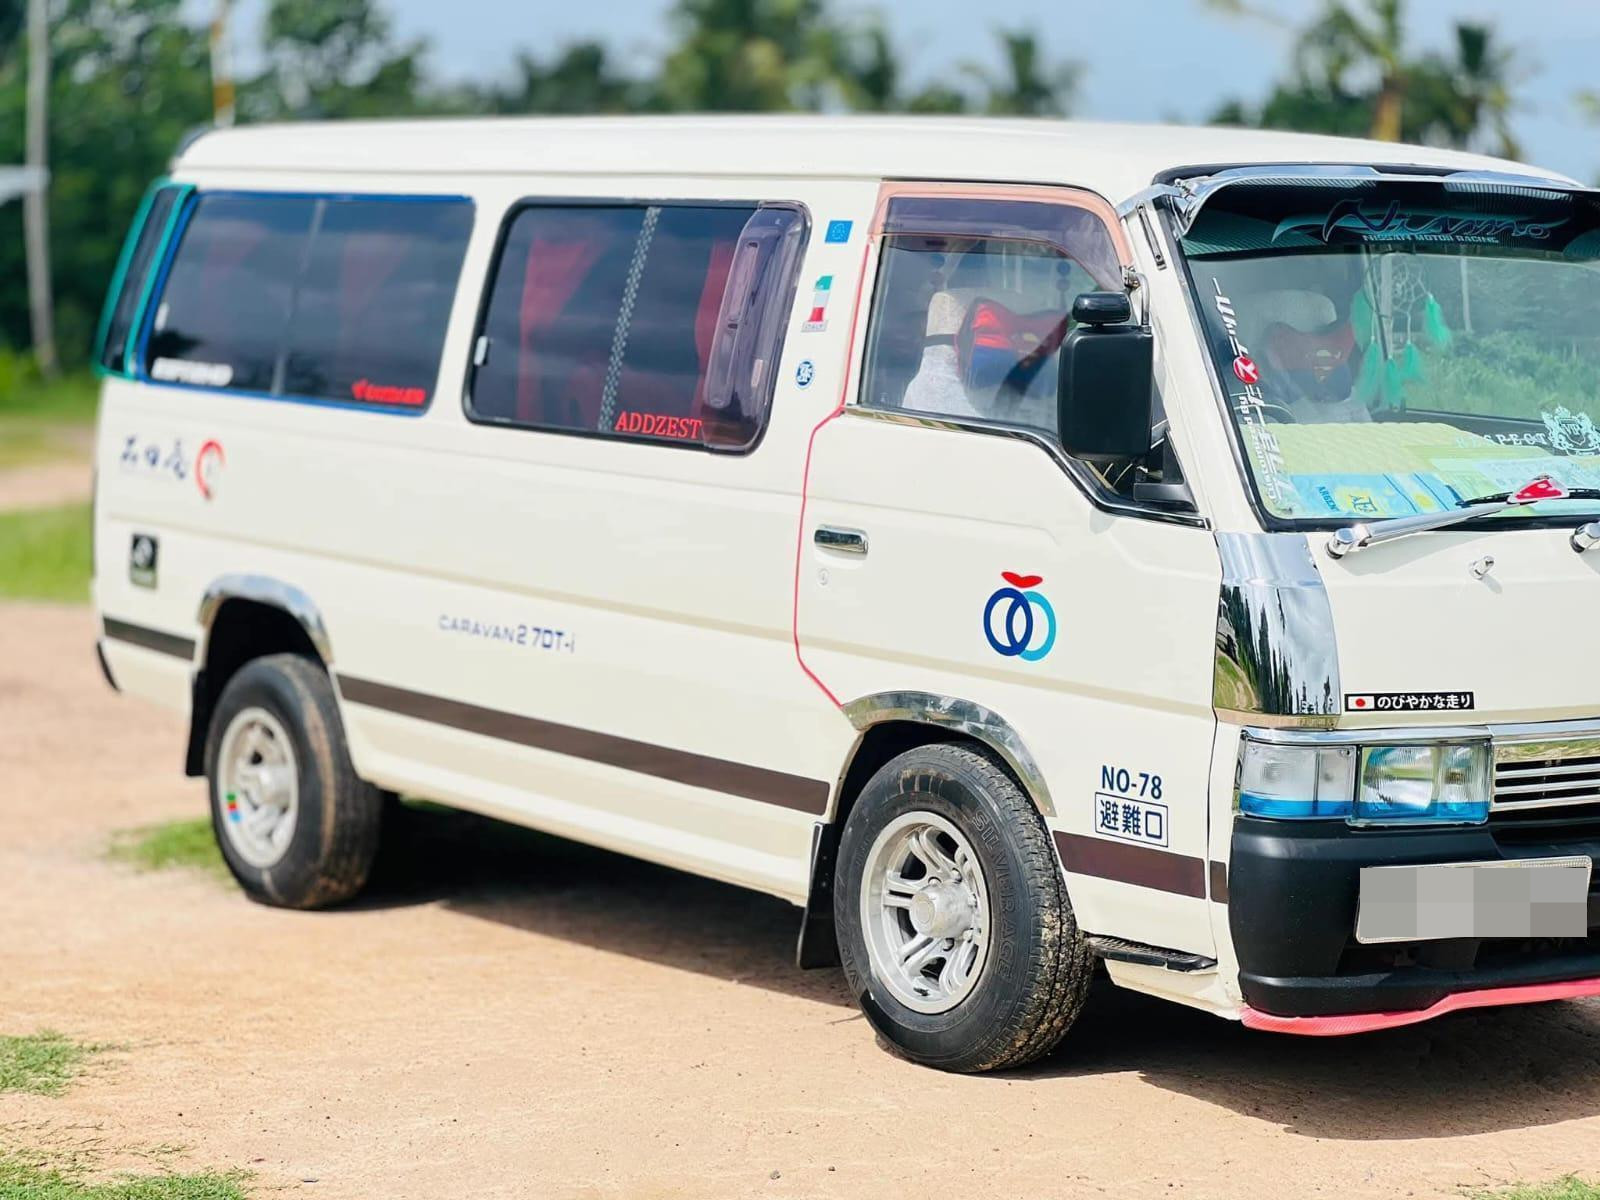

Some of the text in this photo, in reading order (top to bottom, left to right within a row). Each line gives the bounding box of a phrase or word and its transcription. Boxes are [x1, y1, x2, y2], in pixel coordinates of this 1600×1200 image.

[1361, 234, 1500, 244] NISSAN MOTOR RACING
[614, 411, 702, 439] ADDZEST
[438, 614, 514, 643] CARAVAN
[1377, 694, 1470, 709] のびやかな走り
[1102, 765, 1162, 800] NO-78
[1099, 799, 1162, 840] 避難口
